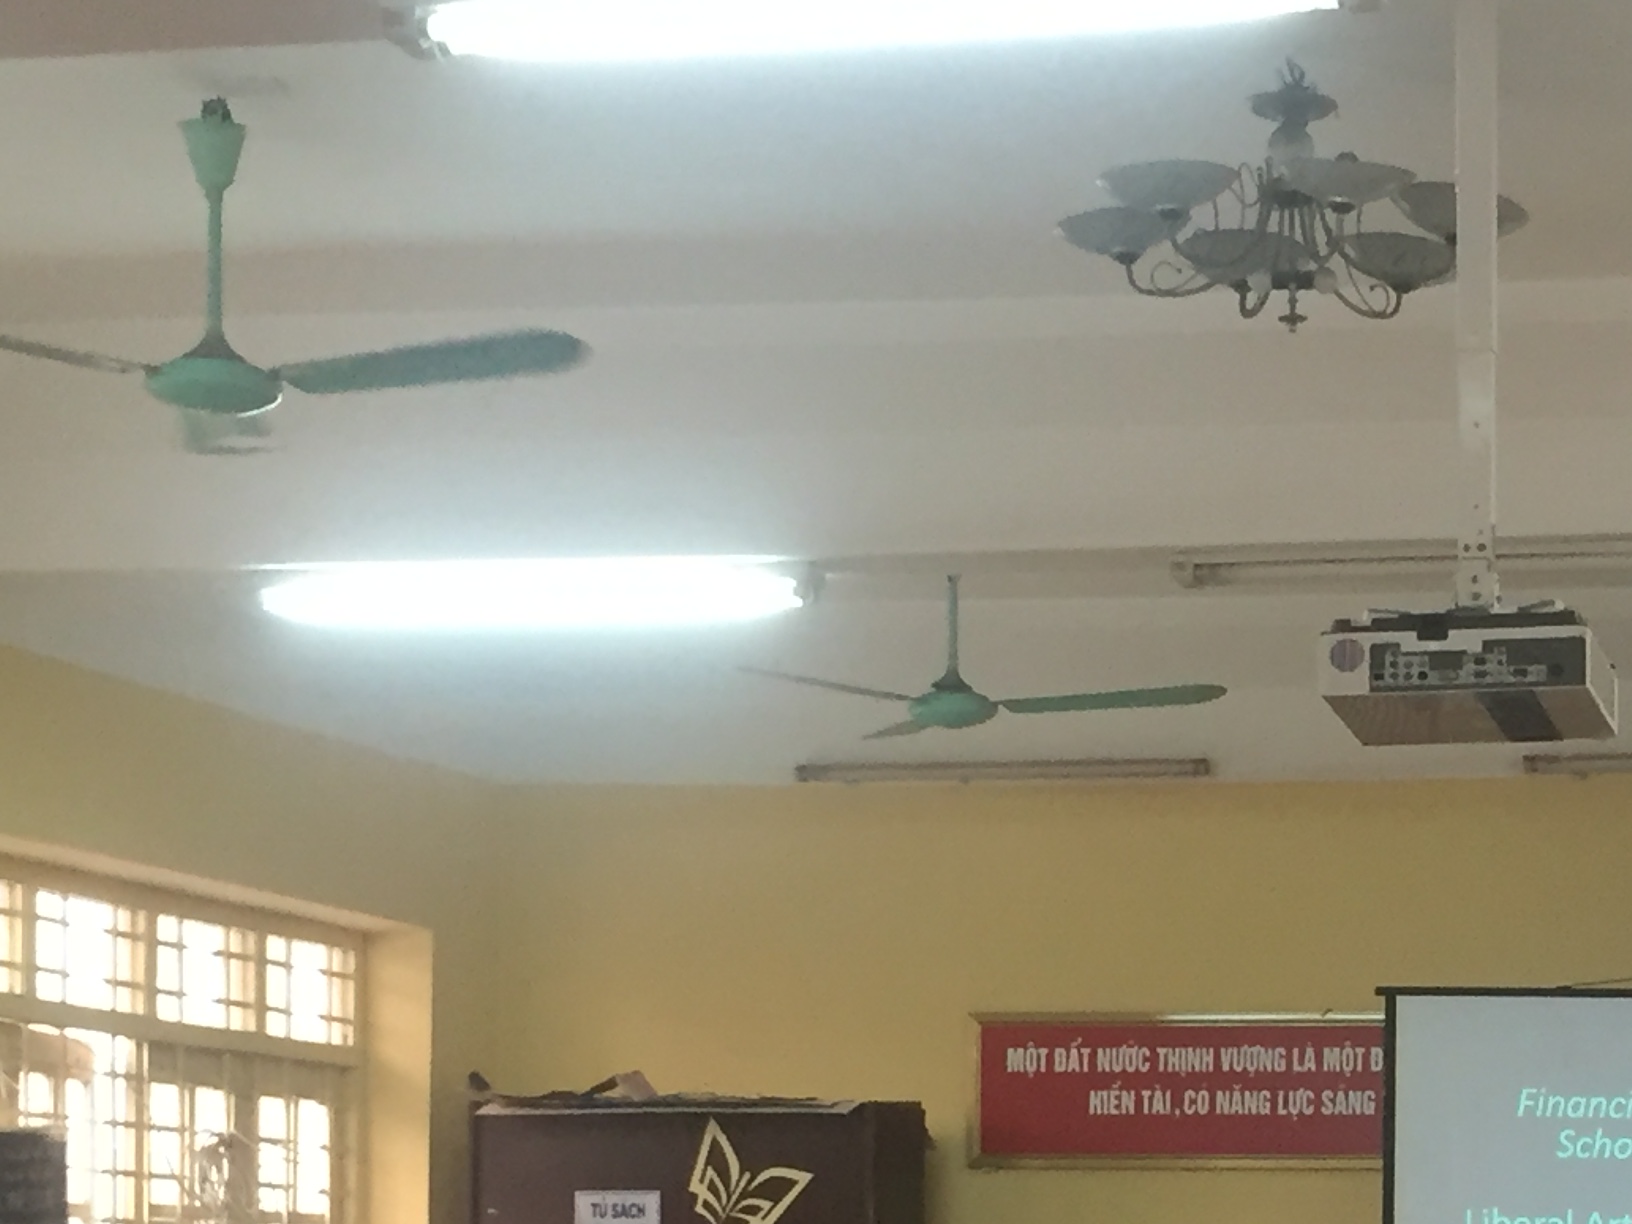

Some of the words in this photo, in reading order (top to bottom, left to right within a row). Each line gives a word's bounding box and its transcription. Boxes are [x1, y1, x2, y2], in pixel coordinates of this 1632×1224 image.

[1007, 1040, 1048, 1078] MỘT
[1054, 1036, 1092, 1073] ĐẤT
[1097, 1040, 1150, 1073] NƯỚC
[1156, 1046, 1214, 1077] THỊNH
[1220, 1044, 1287, 1077] VƯỢNG
[1292, 1041, 1316, 1073] LÀ
[1322, 1040, 1365, 1077] MỘT
[1215, 1084, 1271, 1115] NĂNG
[1277, 1087, 1315, 1121] LỰC
[1321, 1083, 1377, 1115] SÁNG
